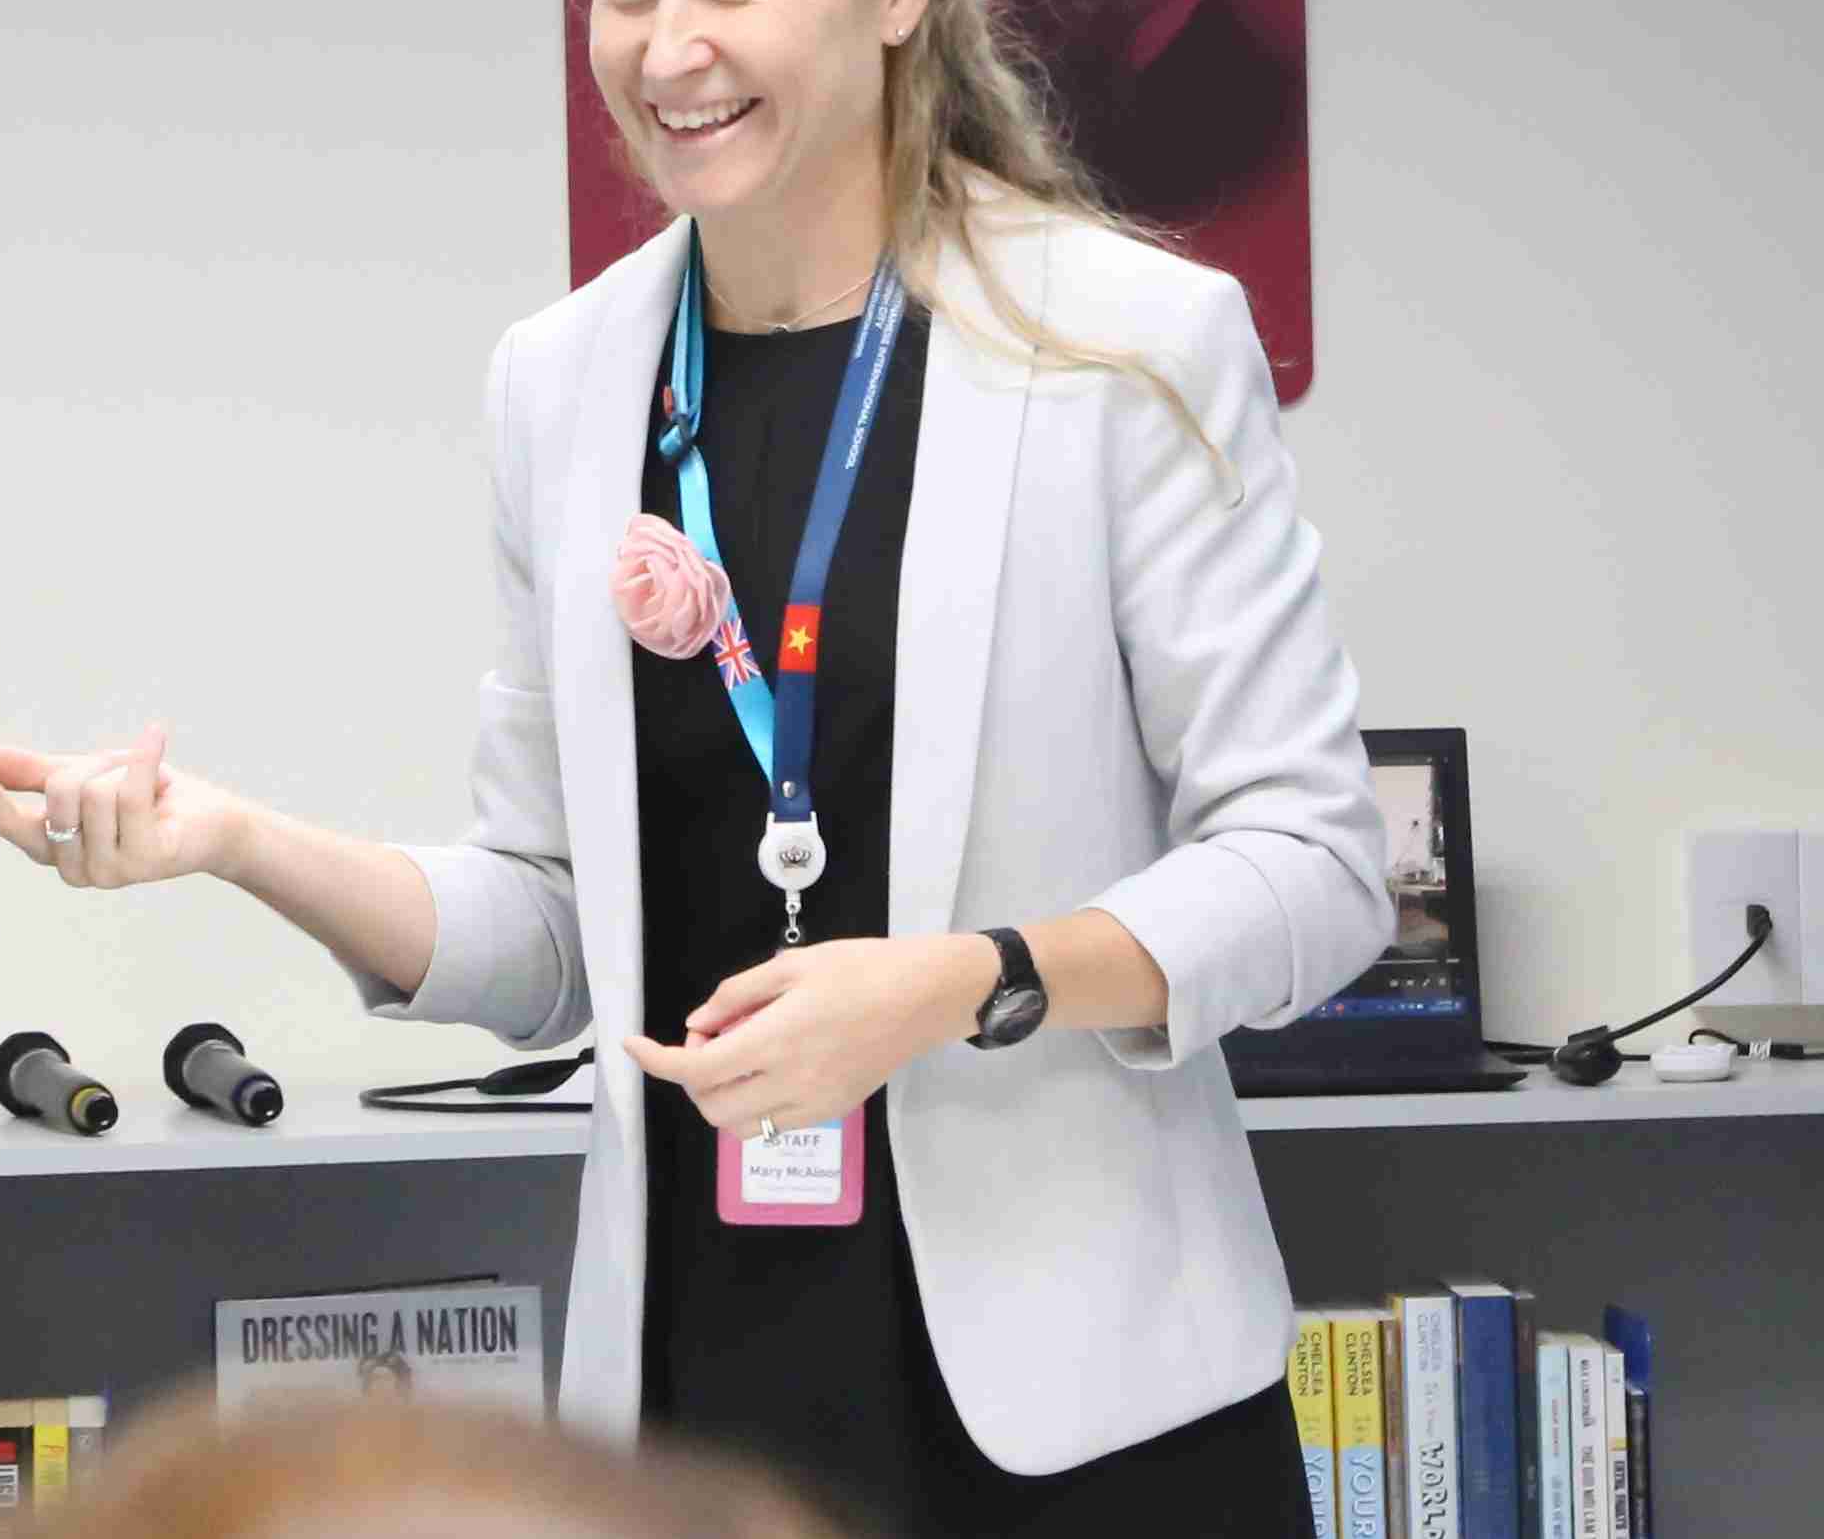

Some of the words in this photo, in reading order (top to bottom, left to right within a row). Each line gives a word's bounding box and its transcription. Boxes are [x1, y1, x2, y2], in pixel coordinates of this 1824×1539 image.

[242, 1312, 378, 1365] DRESSING
[391, 1309, 407, 1354] A
[416, 1306, 519, 1357] NATION
[1311, 1332, 1325, 1397] CHELSEA
[1346, 1333, 1358, 1397] CLINTON
[1360, 1332, 1374, 1397] CHELSEA
[1350, 1453, 1377, 1538] YOUR
